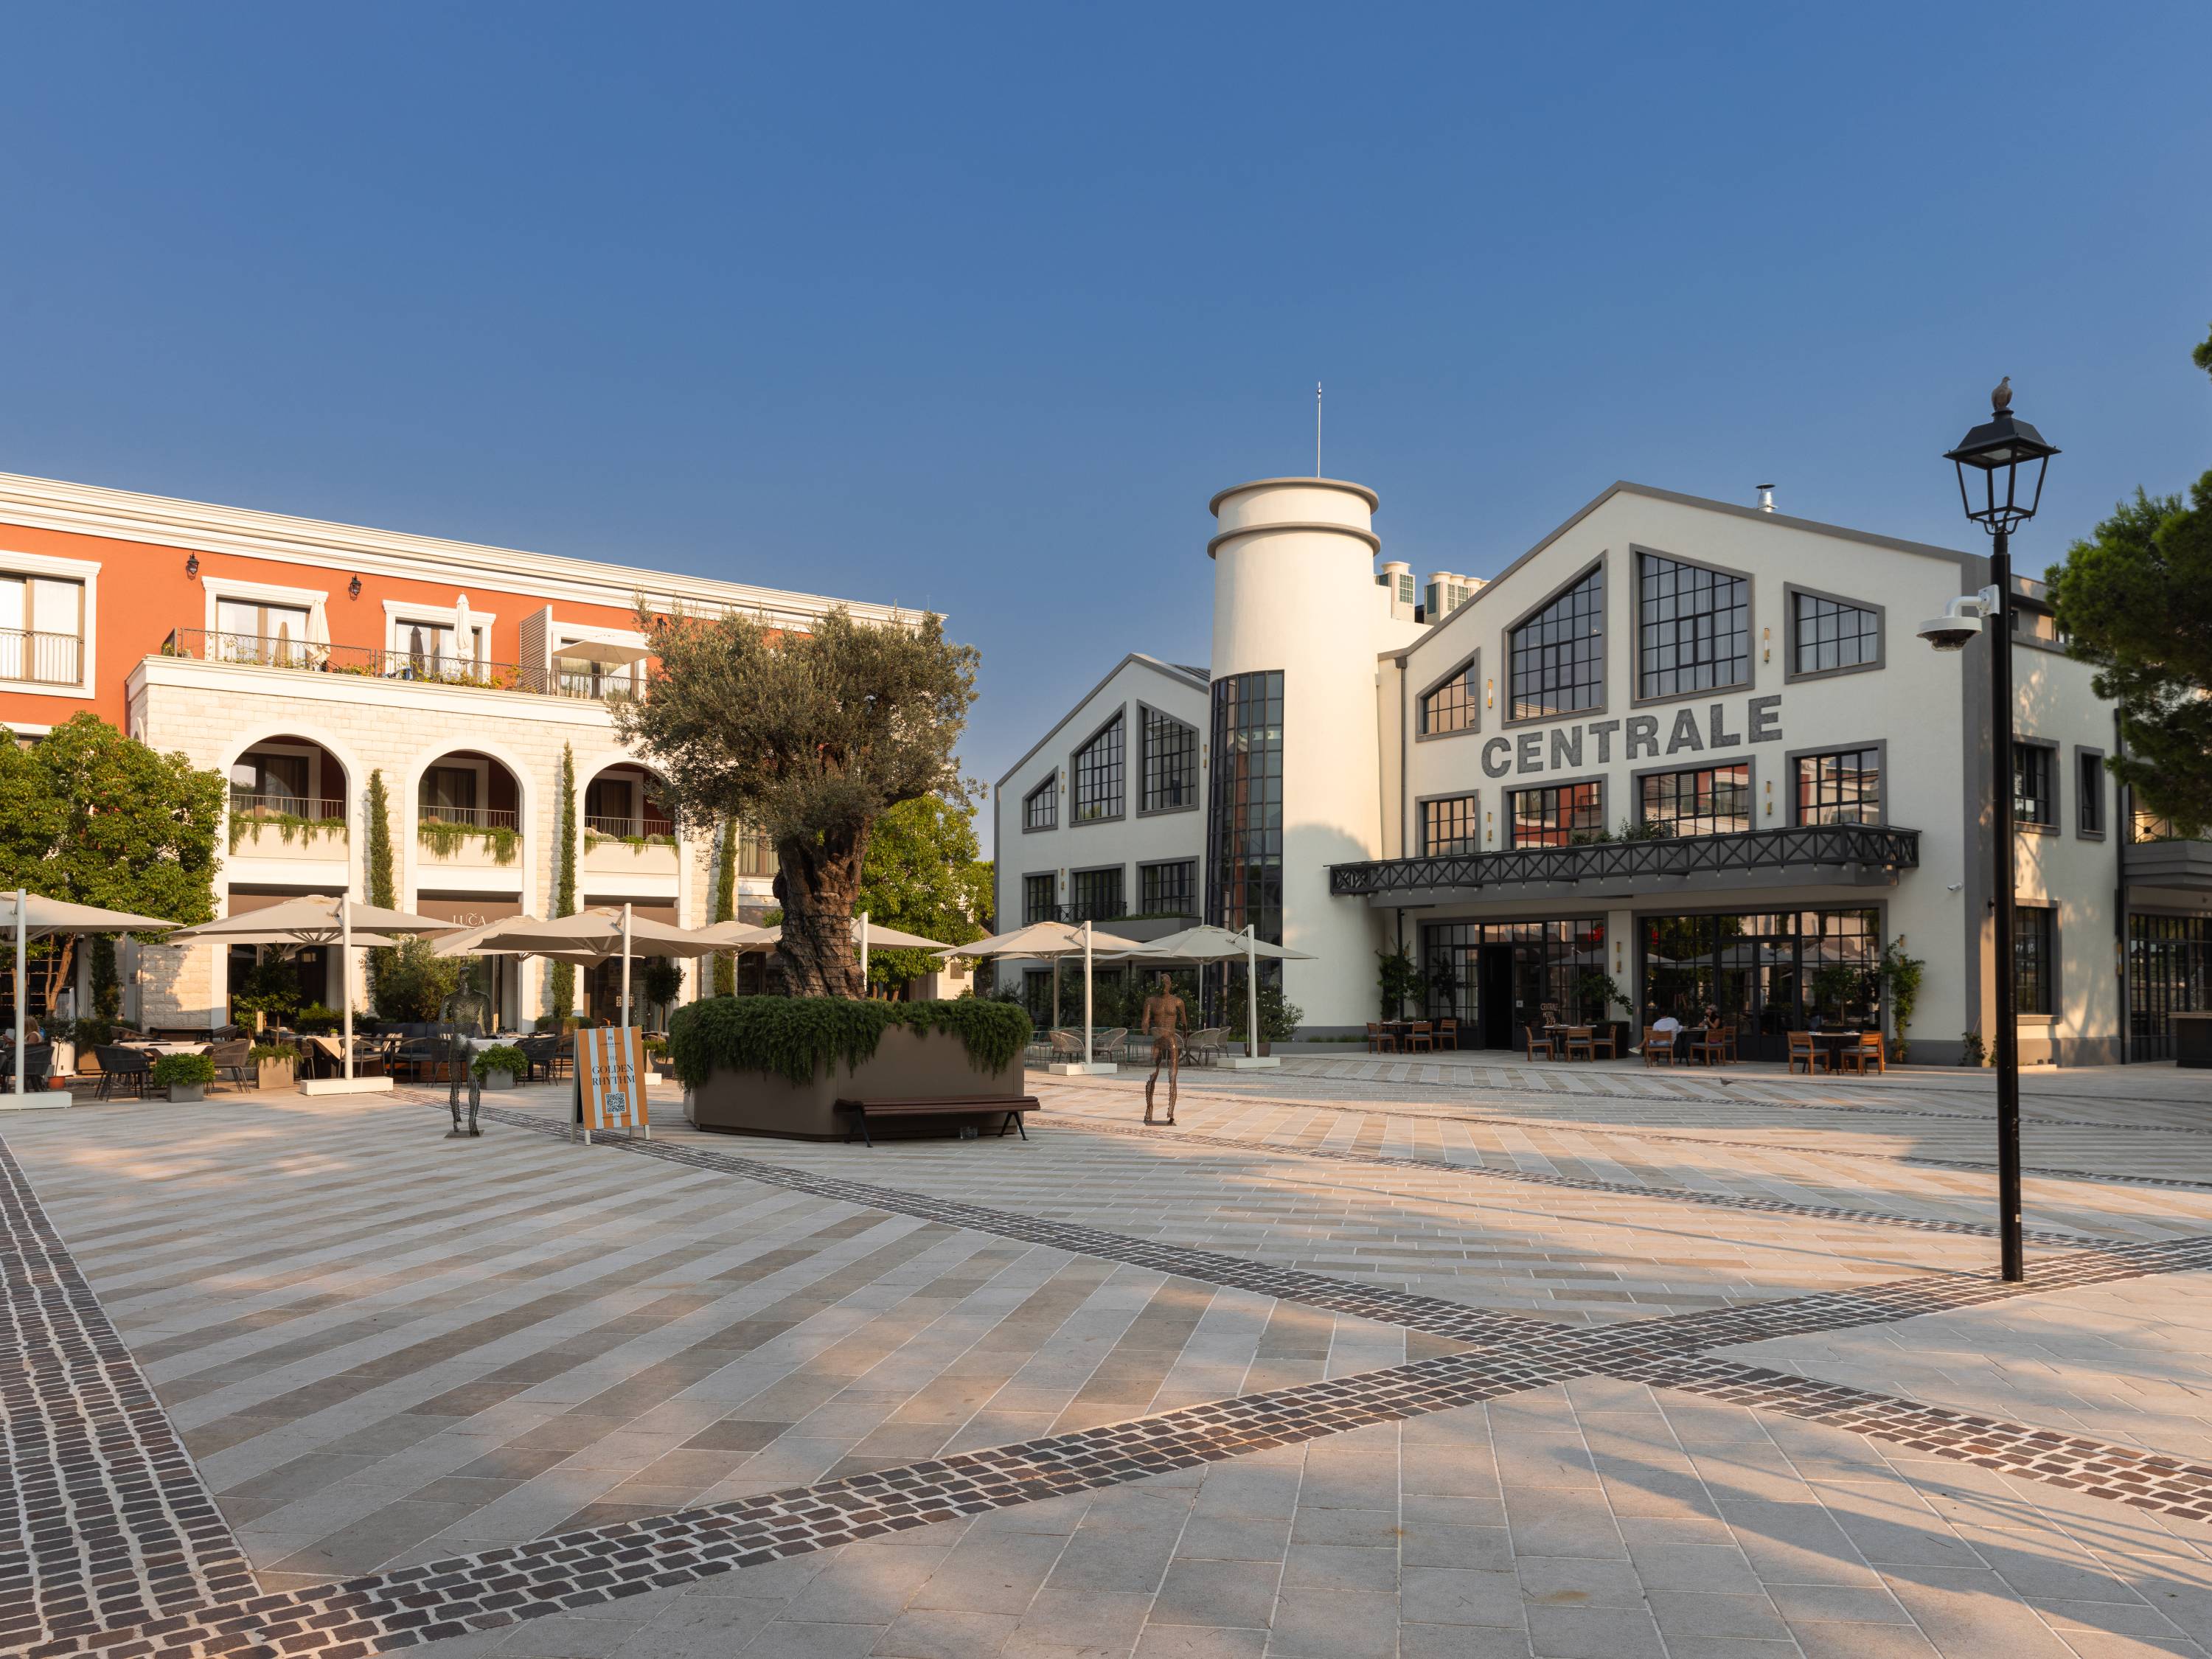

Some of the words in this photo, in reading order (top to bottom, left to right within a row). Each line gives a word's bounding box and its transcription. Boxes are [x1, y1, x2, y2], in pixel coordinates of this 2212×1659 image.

[1481, 694, 1783, 779] CENTRALE
[592, 1063, 634, 1074] GOLDEN
[592, 1075, 636, 1086] RHYTHM
